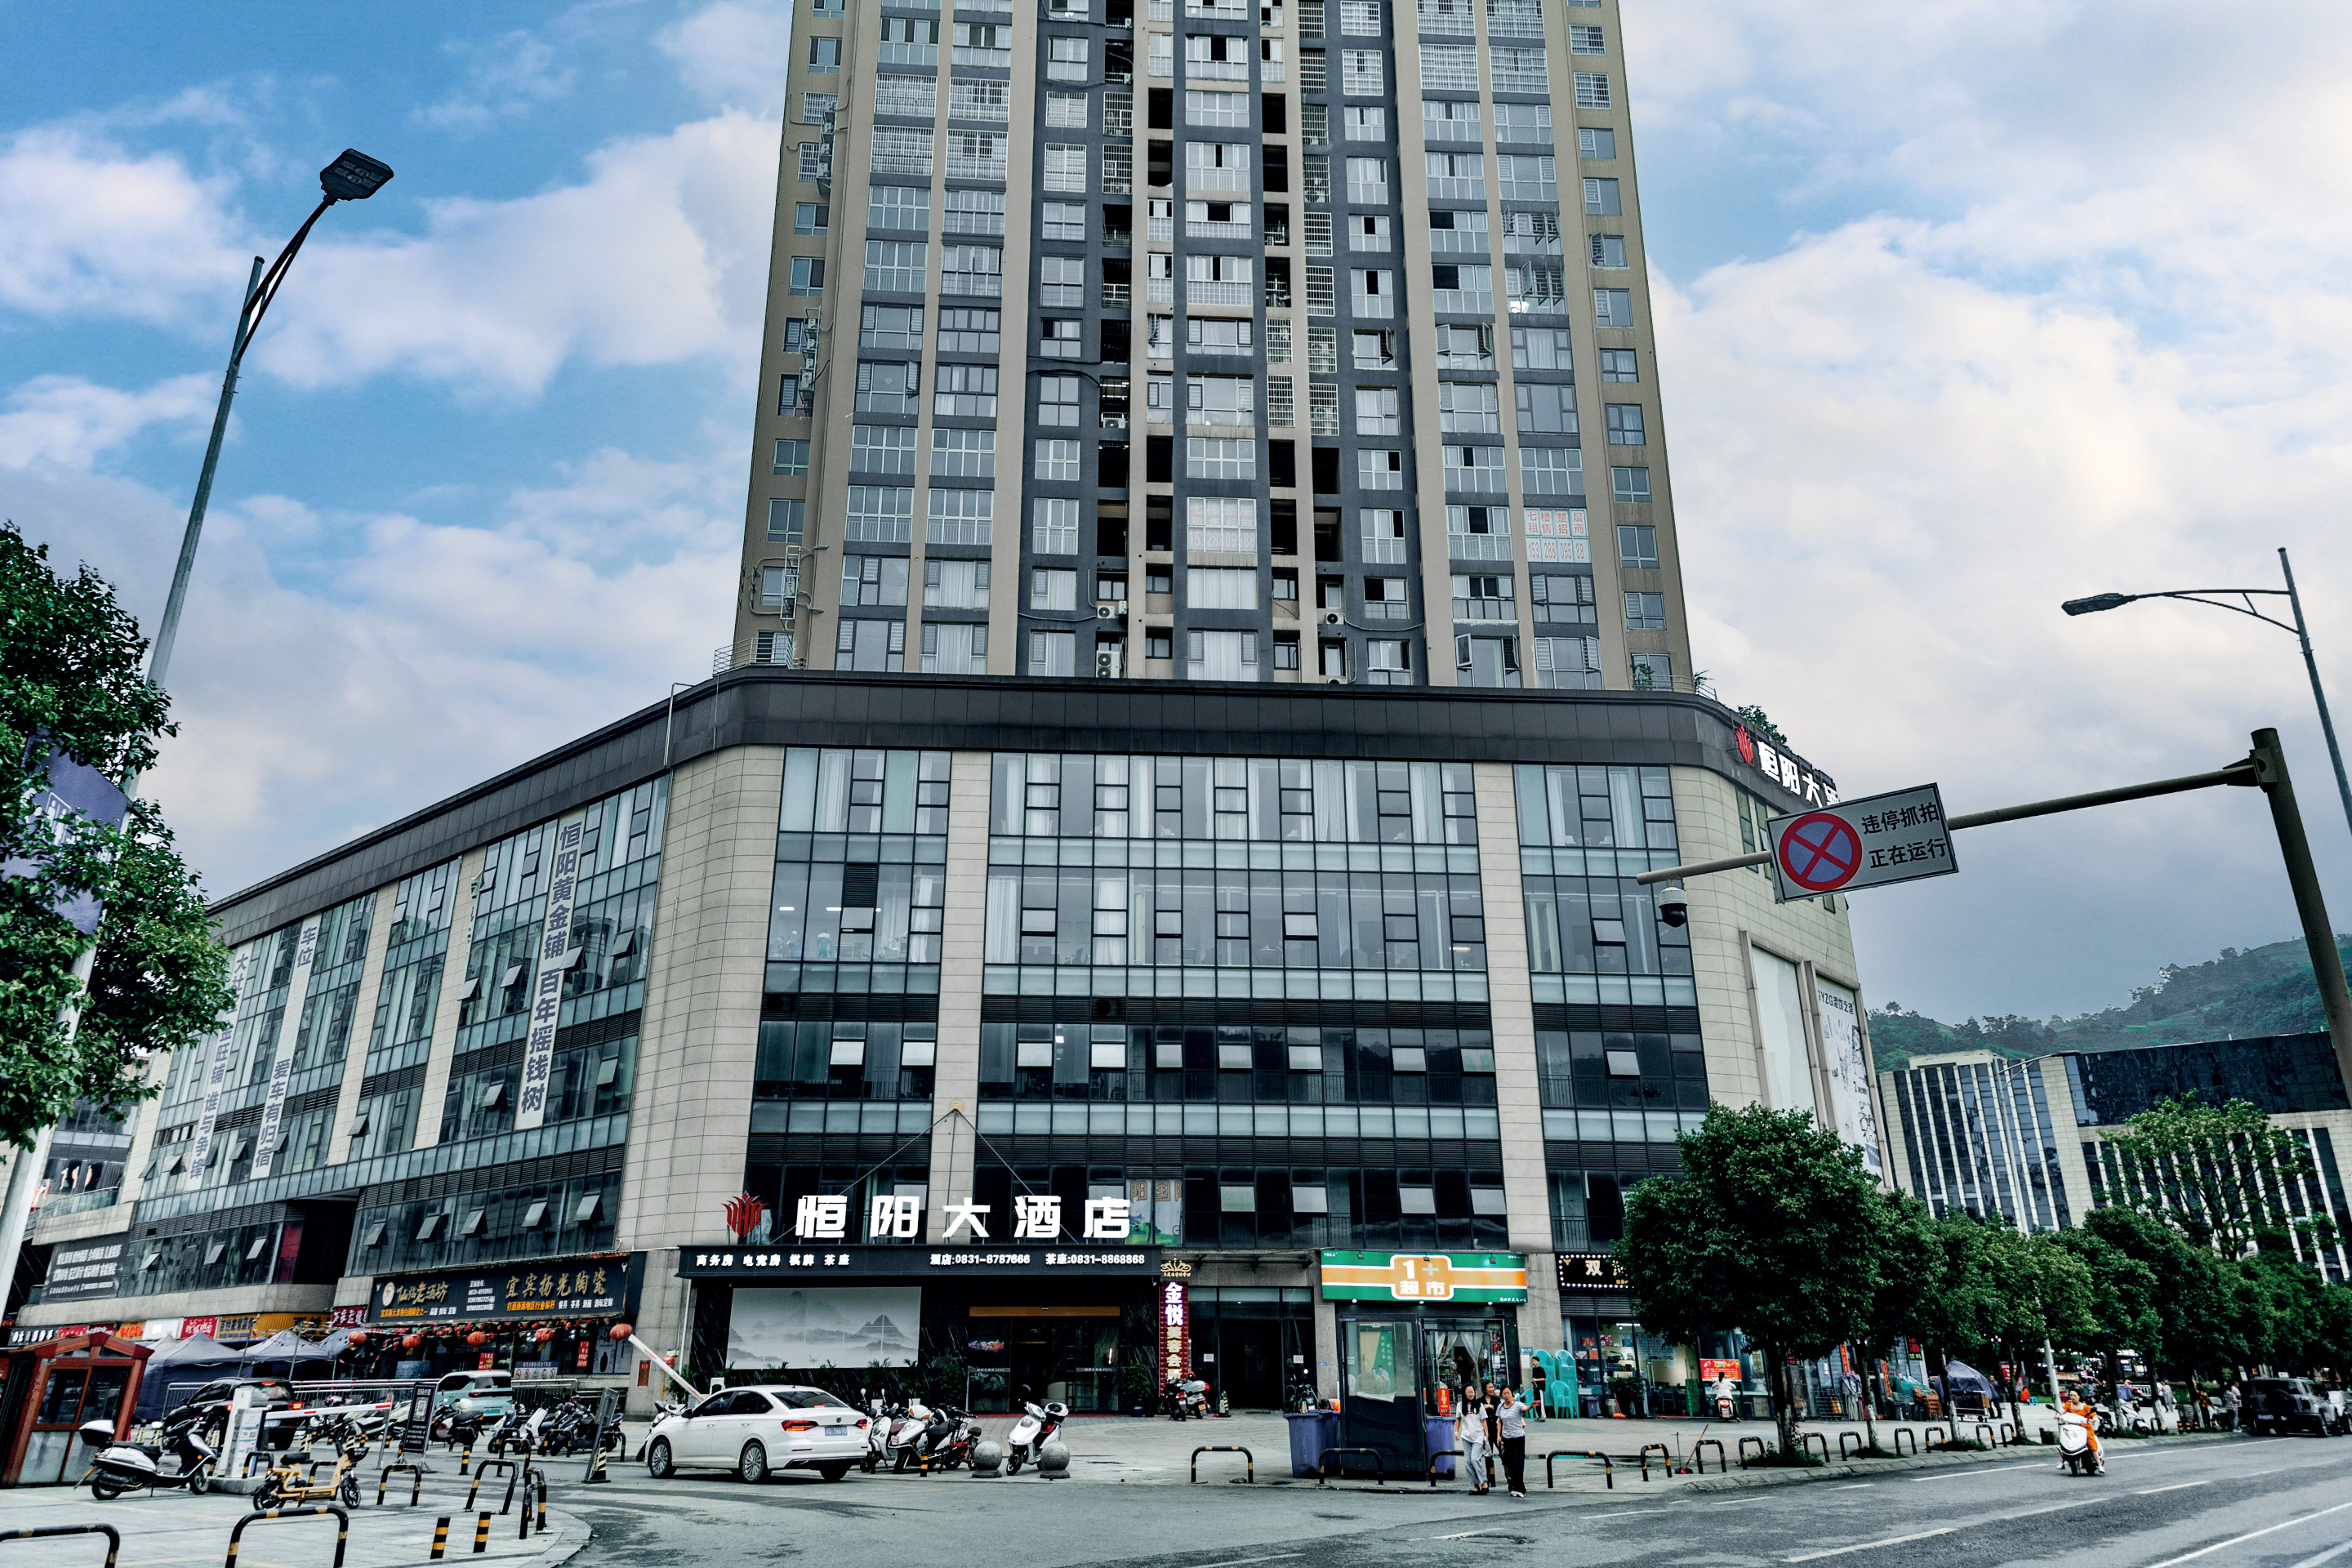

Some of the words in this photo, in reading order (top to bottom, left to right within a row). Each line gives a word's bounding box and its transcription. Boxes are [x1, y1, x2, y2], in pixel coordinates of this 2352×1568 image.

[1191, 502, 1254, 515] 七楼整层
[1527, 511, 1583, 523] 七楼整层
[1528, 523, 1584, 533] 租售招商
[1861, 802, 1940, 835] 违停抓拍
[1869, 838, 1946, 868] 正在运行
[544, 822, 582, 960] 恒阳黄金铺
[521, 968, 560, 1114] 百年摇钱树
[255, 1058, 291, 1168] 爱车有归宿
[189, 1091, 220, 1179] 谁与争锋
[795, 1195, 1131, 1238] 恒阳大酒店
[697, 1254, 733, 1267] 商务房
[742, 1254, 781, 1267] 电竞房
[789, 1254, 814, 1267] 棋牌
[824, 1254, 849, 1266] 茶座
[930, 1254, 1031, 1265] 酒店:0831-8787666
[1045, 1254, 1145, 1265] 茶座:0831-8868868
[1400, 1280, 1445, 1295] 超市
[1165, 1281, 1183, 1381] 金悦美容会所
